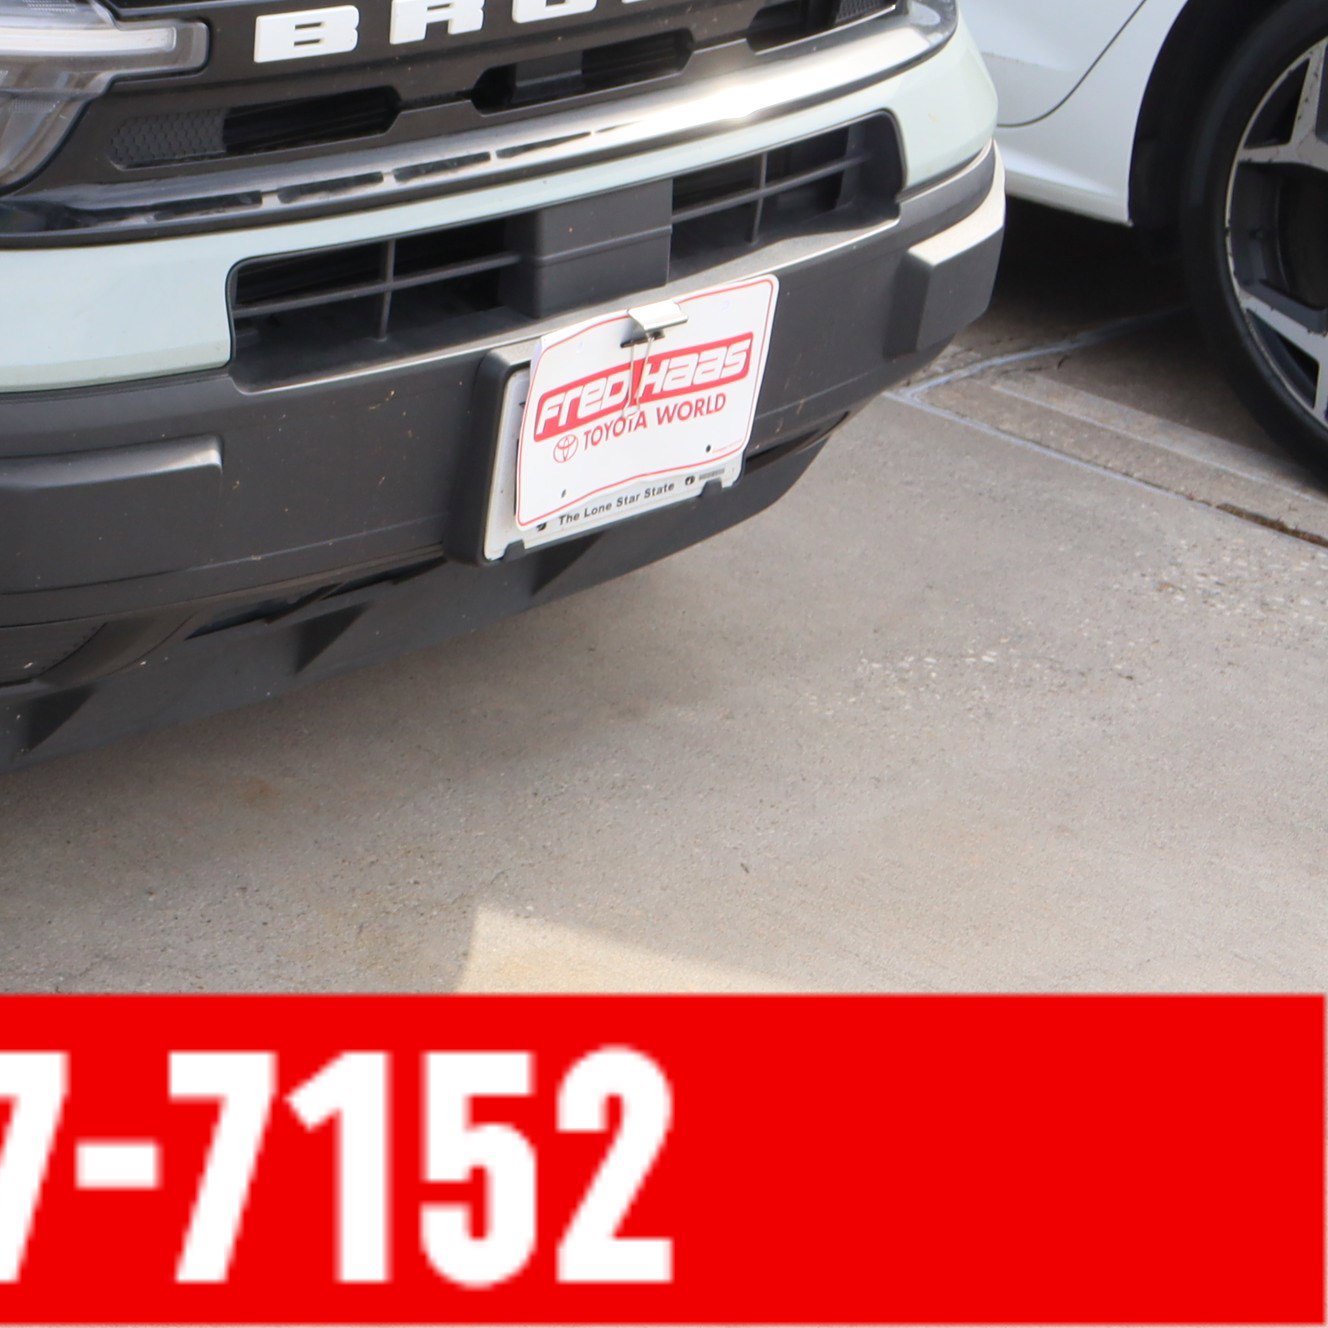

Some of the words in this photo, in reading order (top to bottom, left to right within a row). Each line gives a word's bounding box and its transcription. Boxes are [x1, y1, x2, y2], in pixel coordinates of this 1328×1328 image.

[584, 413, 647, 450] TOYOTA
[656, 392, 726, 425] WORLD
[559, 512, 580, 525] The
[584, 502, 612, 517] Lone
[616, 494, 640, 508] Star
[644, 482, 675, 499] State
